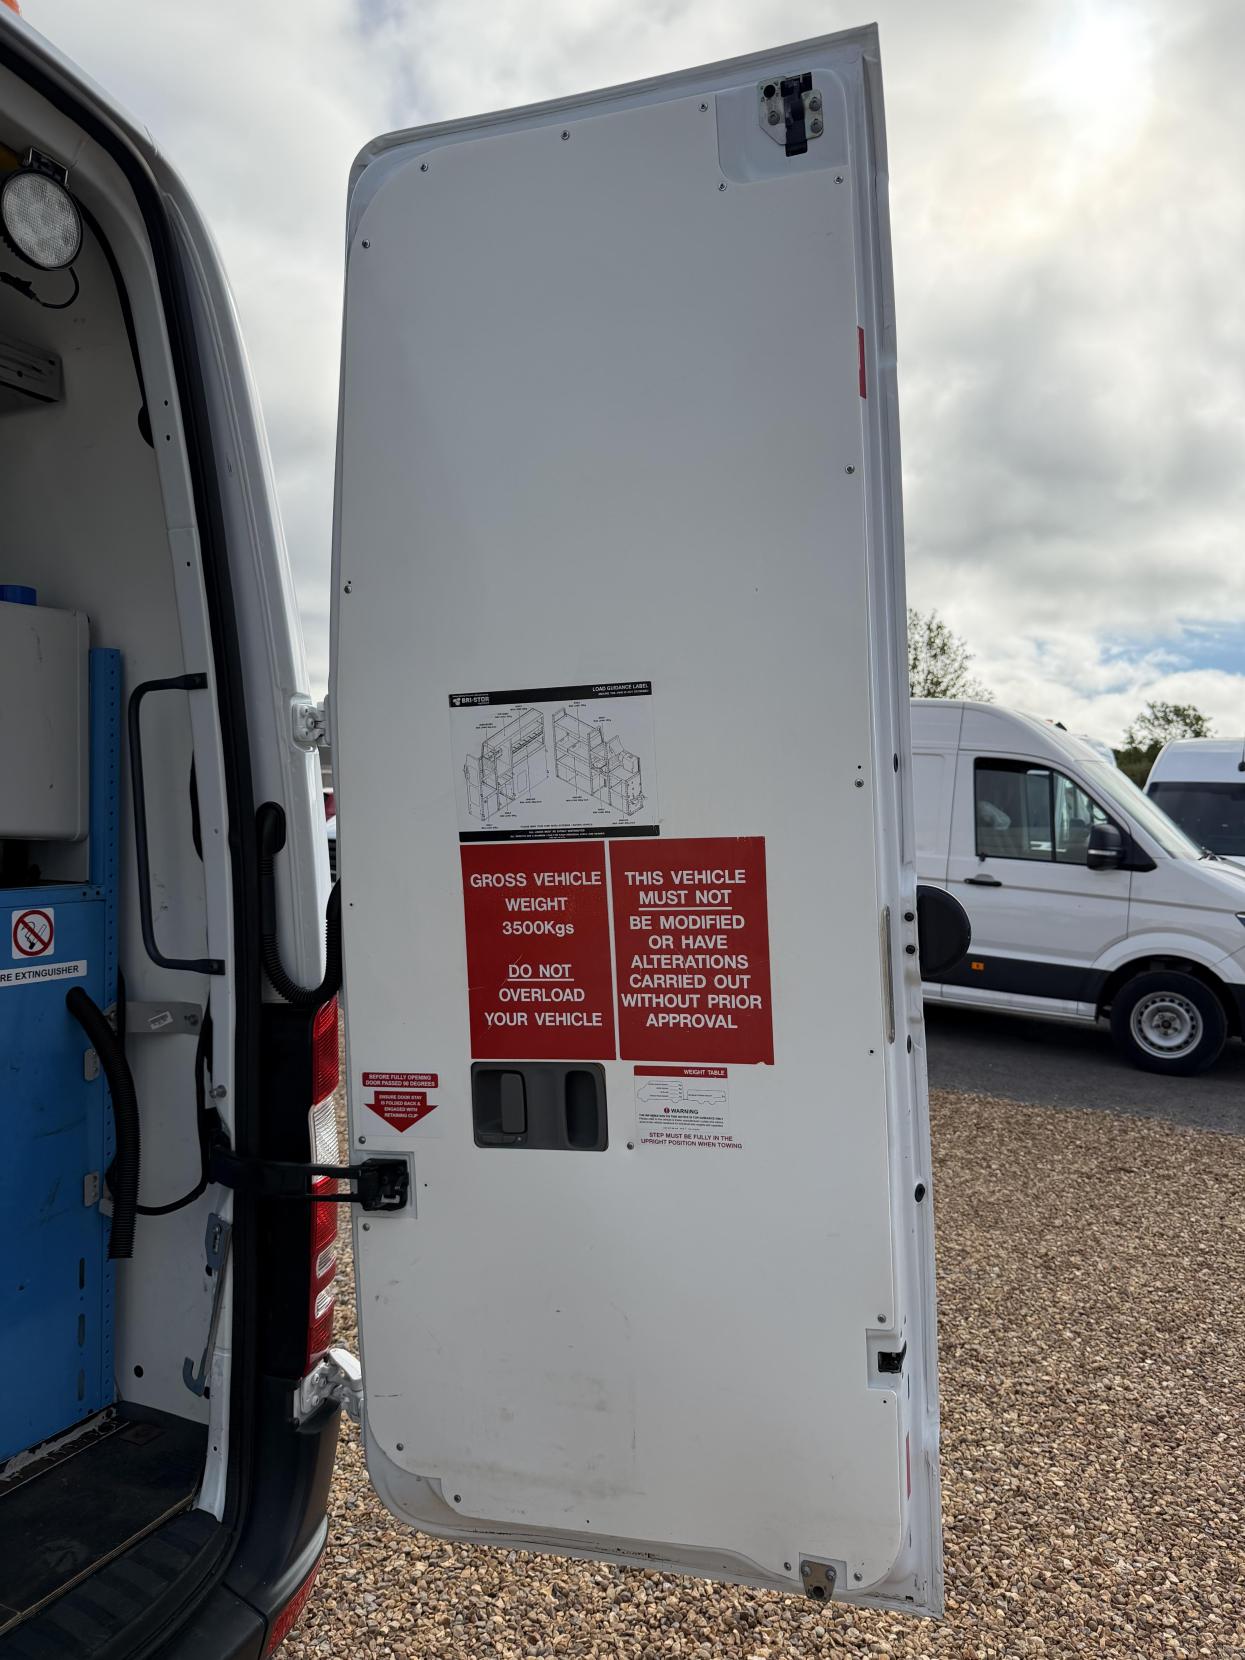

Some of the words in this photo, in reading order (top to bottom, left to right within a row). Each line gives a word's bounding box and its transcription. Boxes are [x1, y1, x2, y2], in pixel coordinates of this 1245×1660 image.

[470, 873, 527, 888] GROSS
[533, 871, 602, 887] VEHICLE
[625, 871, 664, 886] THIS
[671, 869, 746, 885] VEHICLE
[505, 897, 568, 912] WEIGHT
[639, 890, 688, 905] MUST
[695, 889, 732, 904] NOT
[502, 921, 575, 937] 3500Kgs
[629, 915, 652, 930] BE
[659, 915, 745, 930] MODIFIED
[648, 935, 674, 950] OR
[681, 935, 728, 949] HAVE
[631, 955, 749, 970] ALTERATIONS
[15, 964, 79, 981] EXTINGUISHER
[508, 964, 533, 979] DO
[539, 964, 572, 978] NOT
[629, 974, 706, 989] CARRIED
[714, 974, 751, 989] OUT
[498, 988, 585, 1002] OVERLOAD
[621, 994, 701, 1009] WITHOUT
[708, 994, 763, 1010] PRIOR
[484, 1012, 528, 1027] YOUR
[534, 1012, 602, 1027] VEHICLE
[646, 1013, 738, 1029] APPROVAL
